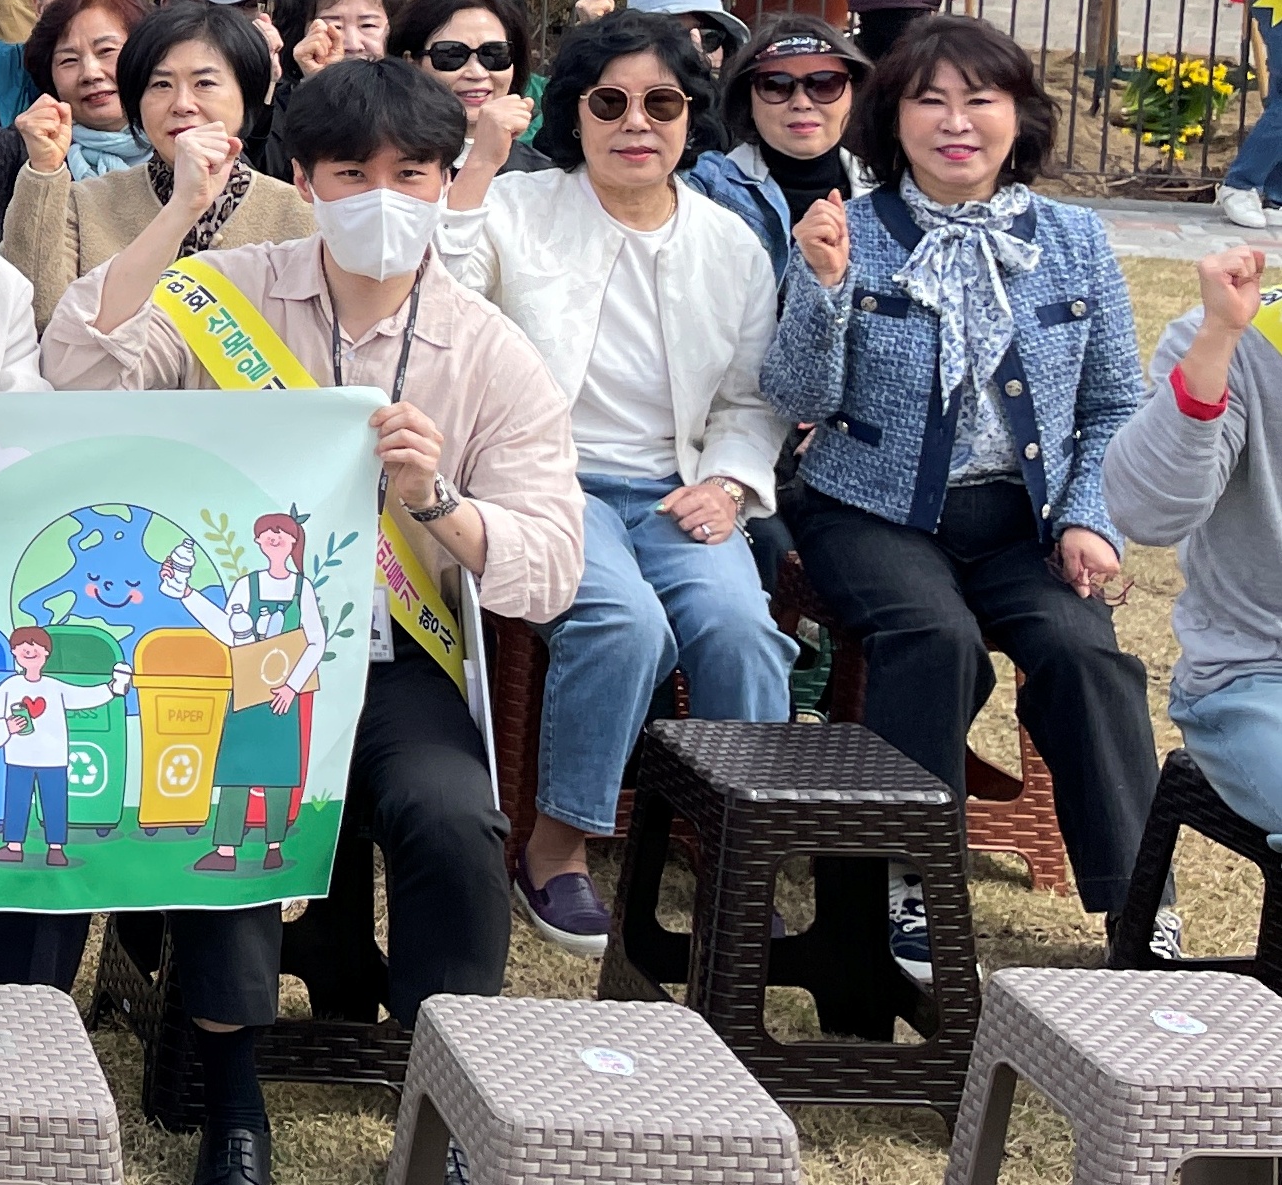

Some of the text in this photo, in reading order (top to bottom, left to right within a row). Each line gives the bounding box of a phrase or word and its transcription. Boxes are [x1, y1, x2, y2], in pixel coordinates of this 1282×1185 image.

[208, 307, 272, 383] 식목일
[376, 532, 420, 612] 만들기
[418, 604, 457, 654] 행사
[167, 709, 203, 723] PAPER
